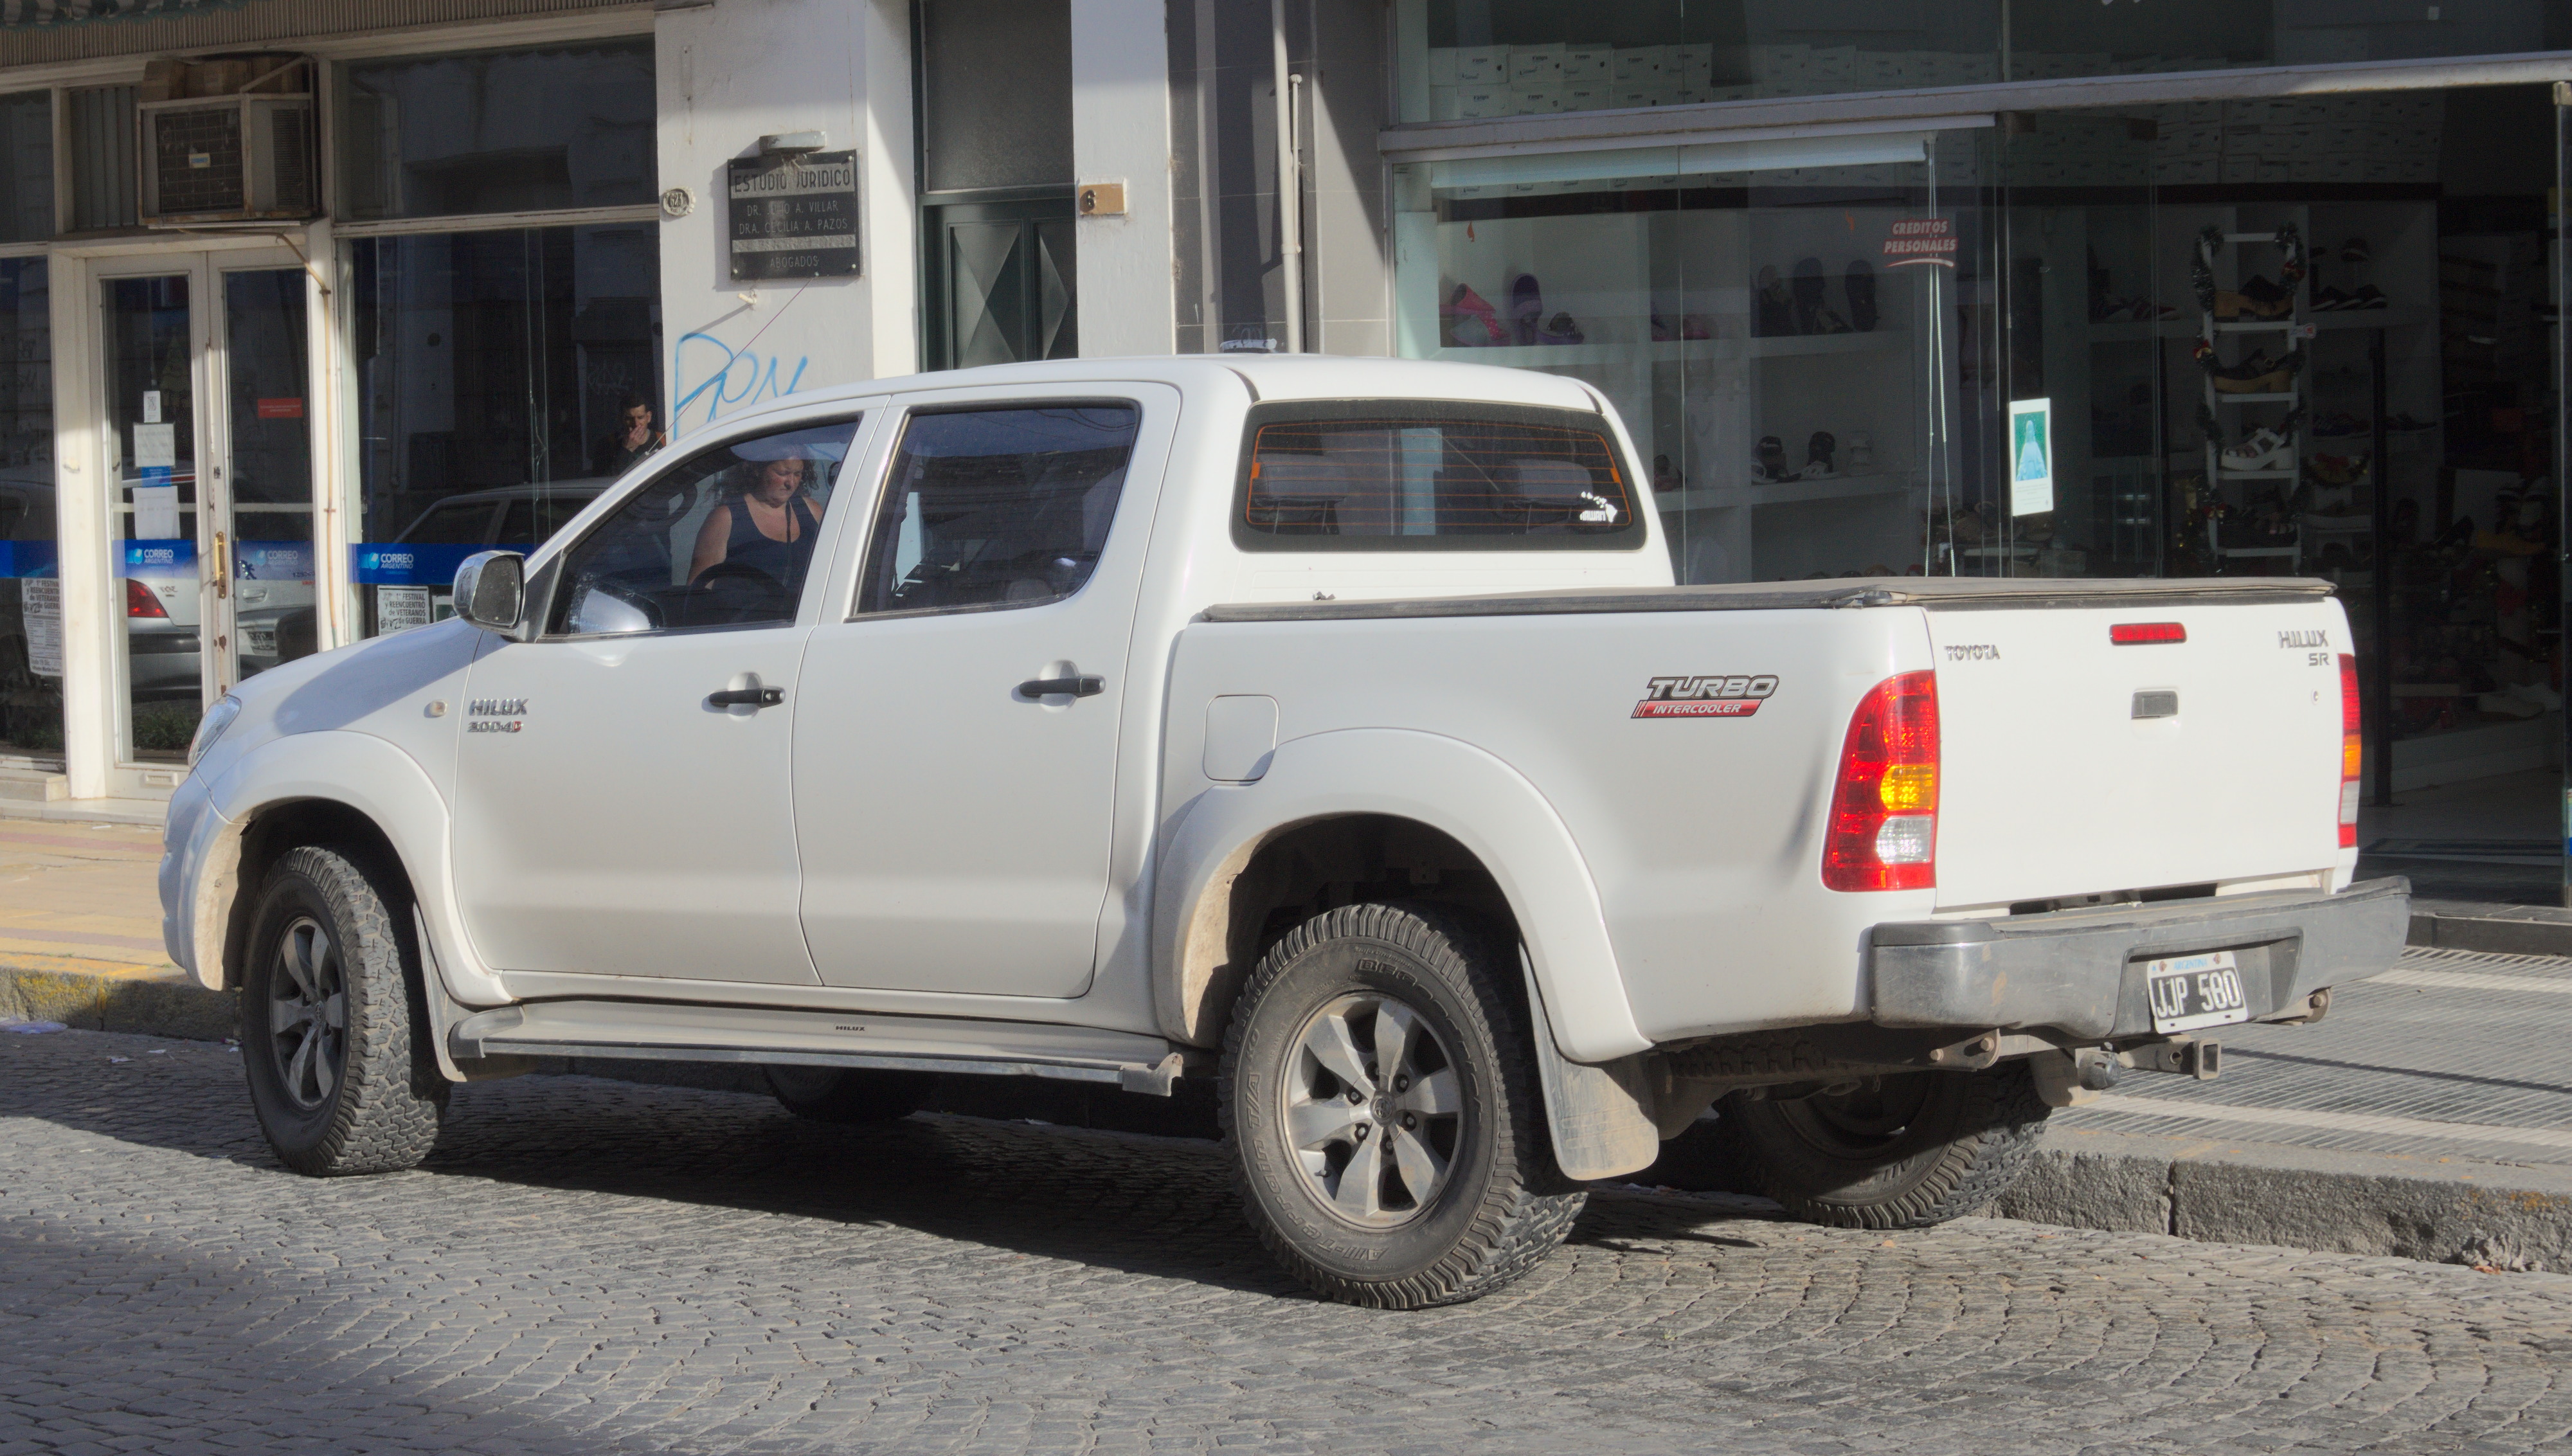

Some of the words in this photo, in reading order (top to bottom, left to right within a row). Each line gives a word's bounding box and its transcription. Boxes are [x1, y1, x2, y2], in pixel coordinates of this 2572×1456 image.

[735, 172, 787, 192] ESTUDIO
[796, 169, 850, 188] JURIDICO
[747, 204, 761, 216] DR.
[795, 202, 804, 213] A.
[809, 200, 838, 213] VILLAR
[739, 223, 759, 235] DRA.
[765, 220, 799, 233] CECILIA
[805, 220, 813, 231] A.
[818, 218, 847, 230] PAZOS
[1884, 238, 1956, 253] PERSONALES
[770, 255, 818, 268] ABOGADOS
[143, 549, 174, 559] CORREO
[267, 550, 298, 560] CORREO
[381, 553, 414, 563] CORREO
[2278, 629, 2328, 649] HILUX
[1943, 644, 2001, 661] TOYOTA
[2308, 652, 2330, 667] SR
[1646, 674, 1779, 700] TURBO
[469, 698, 529, 716] HILUX
[1652, 703, 1742, 714] INTERCOOLER
[2173, 958, 2208, 971] ARGENTINA
[2156, 976, 2189, 1018] JJP
[2197, 969, 2242, 1012] 580
